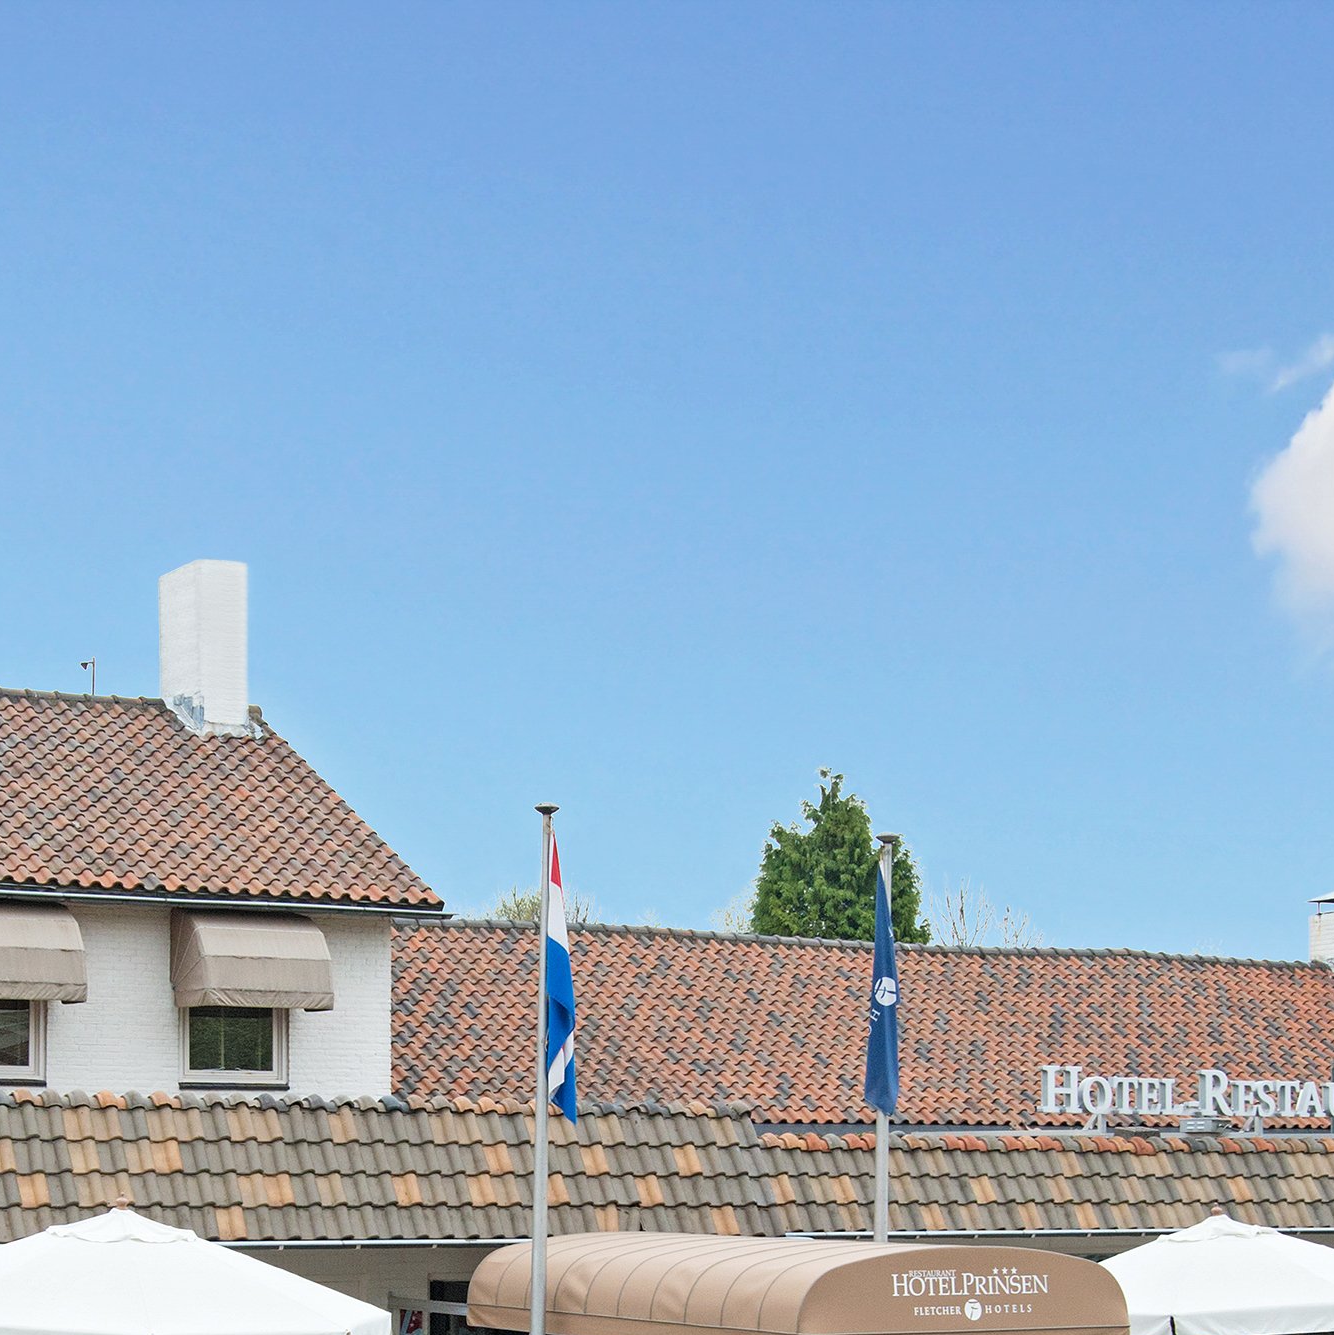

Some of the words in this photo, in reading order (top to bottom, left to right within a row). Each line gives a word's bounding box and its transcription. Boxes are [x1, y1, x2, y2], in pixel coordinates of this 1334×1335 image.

[1037, 1065, 1185, 1115] HOTEL
[908, 1269, 957, 1278] RESTAURANT
[914, 1305, 962, 1316] FLETCHER
[985, 1303, 1033, 1314] HOTELS
